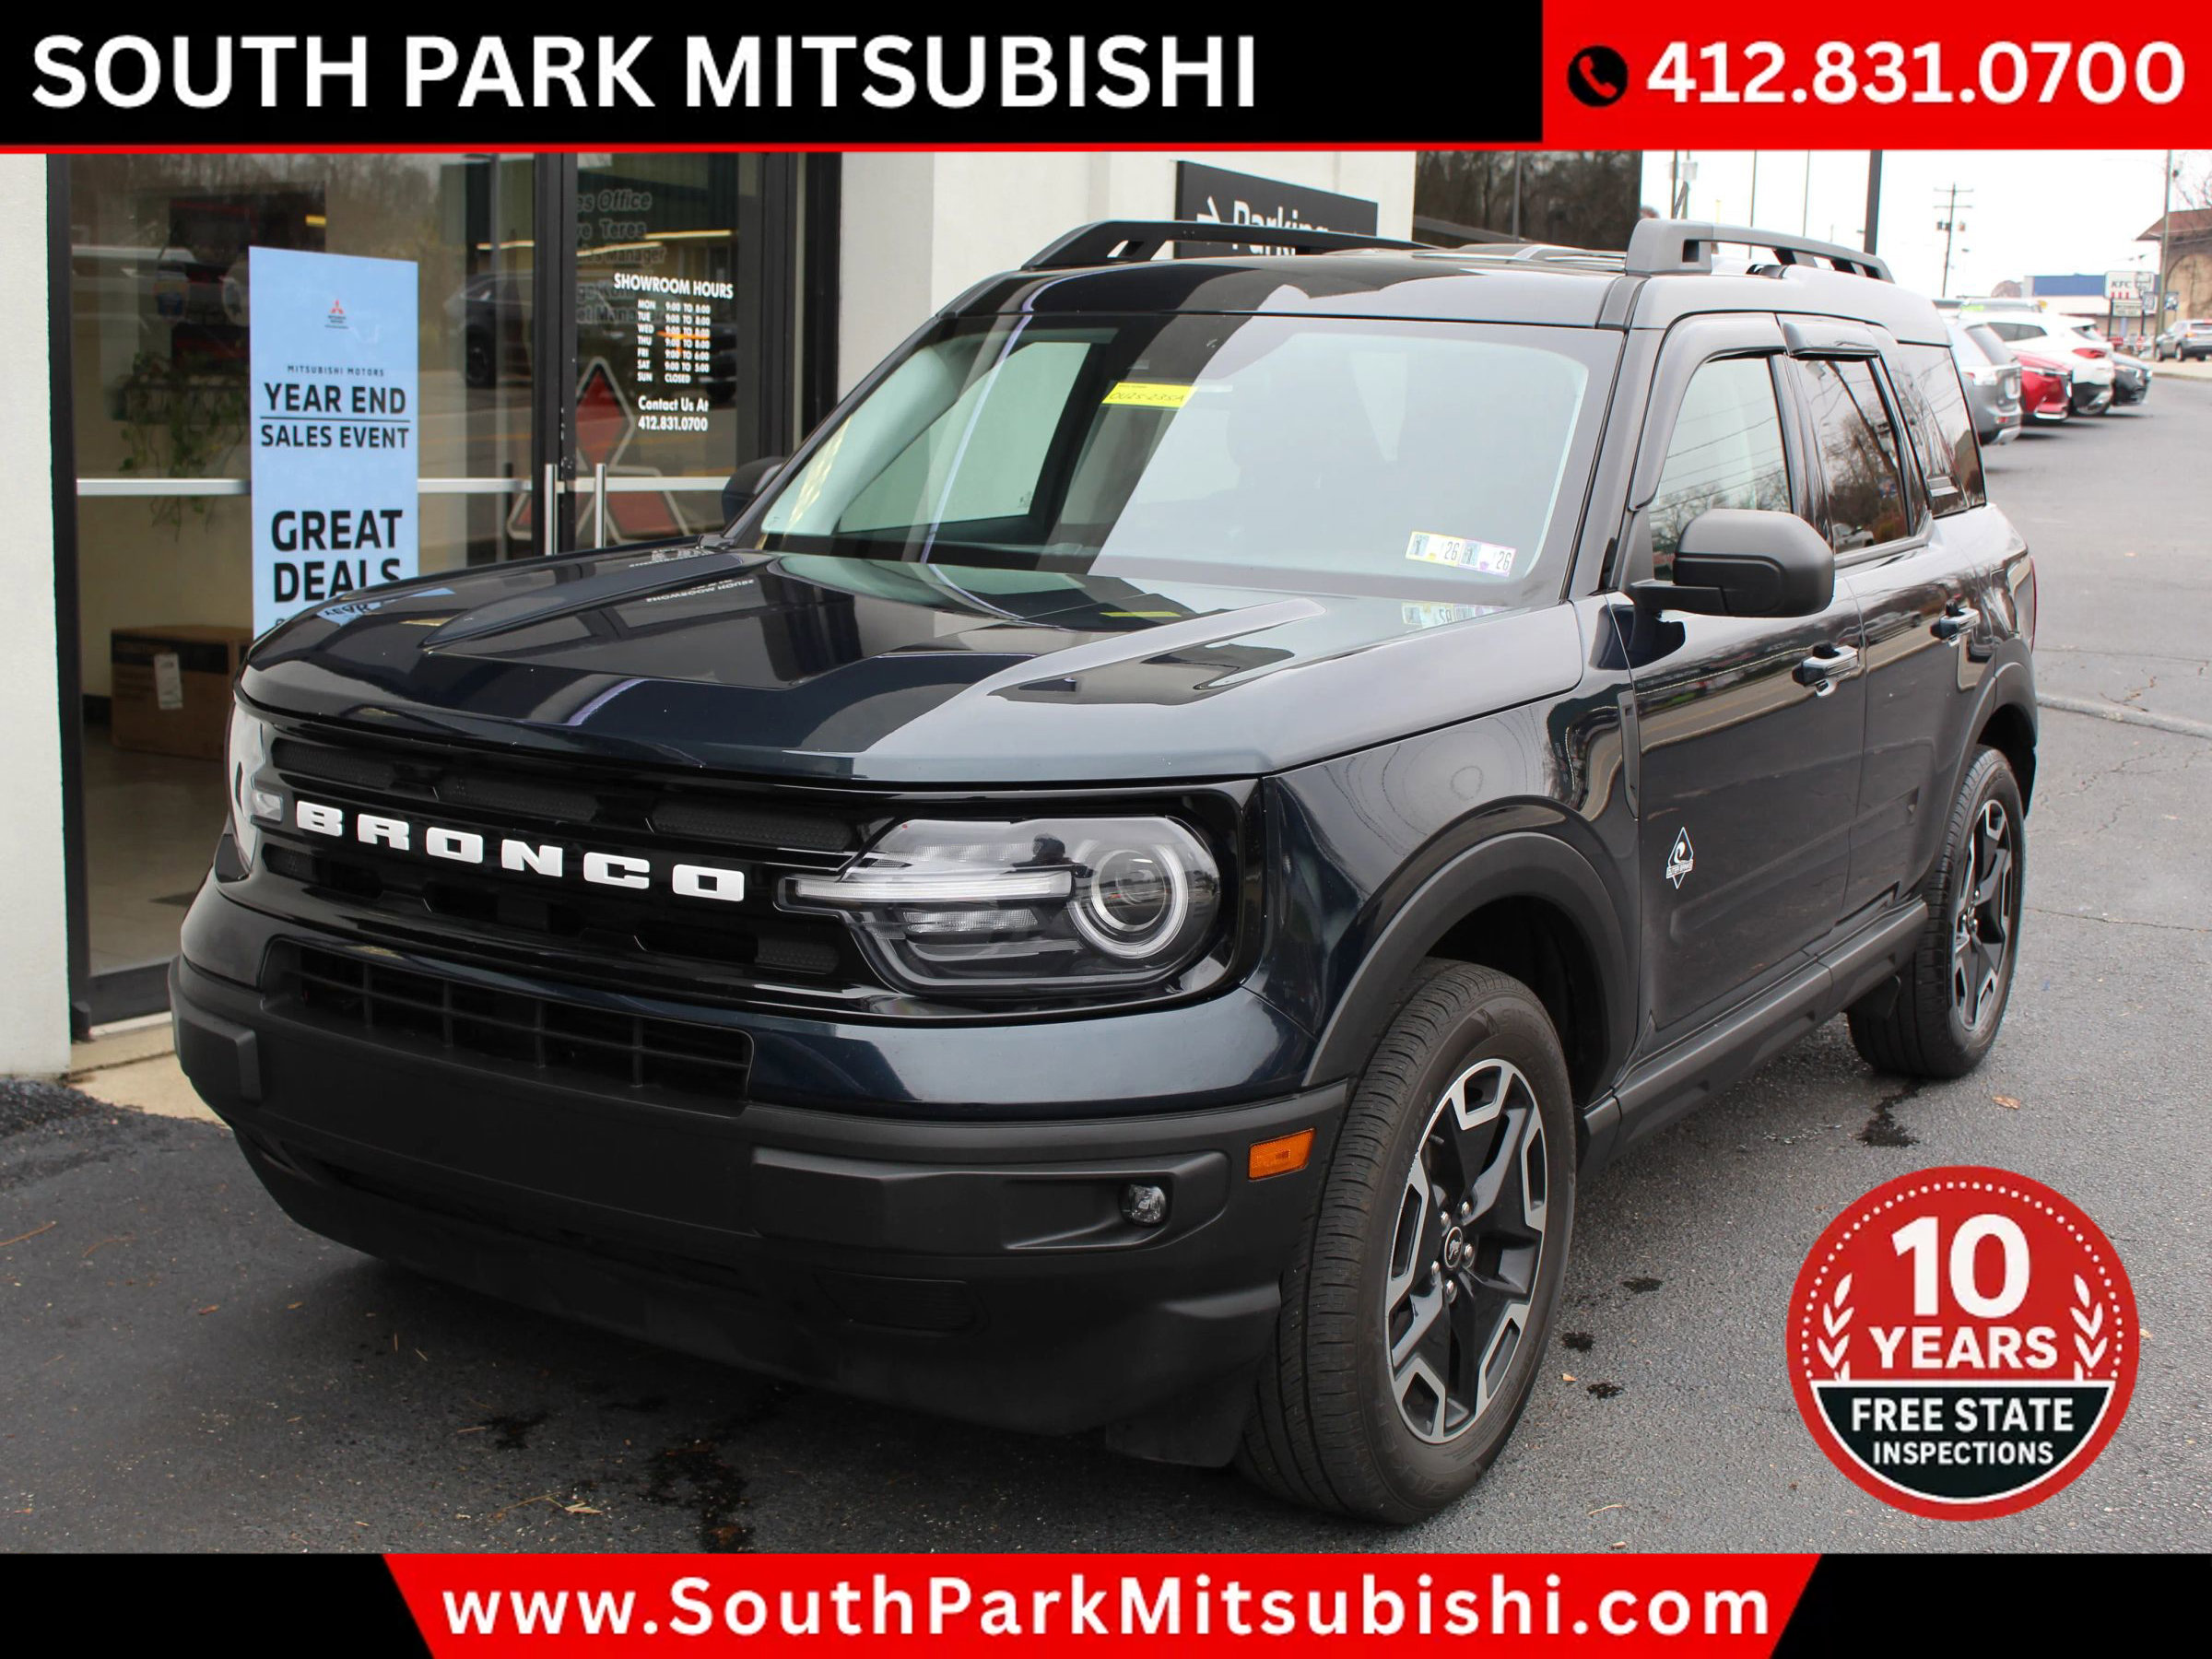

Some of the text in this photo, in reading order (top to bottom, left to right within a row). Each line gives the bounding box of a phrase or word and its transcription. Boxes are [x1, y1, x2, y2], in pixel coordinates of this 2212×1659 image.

[1232, 199, 1329, 255] Parki
[613, 272, 691, 296] SHOWROOM
[693, 280, 734, 300] HOURS
[2111, 280, 2131, 288] KFC
[637, 299, 656, 310] MON
[665, 301, 681, 312] 9:00
[683, 303, 693, 313] TO
[637, 311, 651, 322] TUE
[665, 313, 680, 324] 9:00
[683, 314, 693, 324] TO
[637, 324, 654, 334] WED
[665, 325, 681, 335] 9:00
[683, 326, 693, 336] TO
[637, 335, 653, 346] THU
[665, 337, 680, 347] 9:00
[683, 338, 693, 348] TO
[637, 347, 649, 358] FRI
[665, 349, 680, 359] 9:00
[682, 350, 693, 360] TO
[287, 365, 384, 377] MITSUBISHI MOTORS
[637, 359, 651, 370] SAT
[665, 360, 680, 371] 9:00
[681, 361, 692, 372] TO
[637, 371, 691, 383] SUN CLOSED
[265, 382, 406, 414] YEAR END
[638, 394, 709, 413] Contact Us At
[638, 415, 709, 431] 412.831.0700
[261, 424, 409, 449] SALES EVENT
[271, 510, 403, 551] GREAT
[1444, 541, 1460, 561] 26
[1496, 551, 1512, 571] 26
[296, 800, 745, 902] BRONCO
